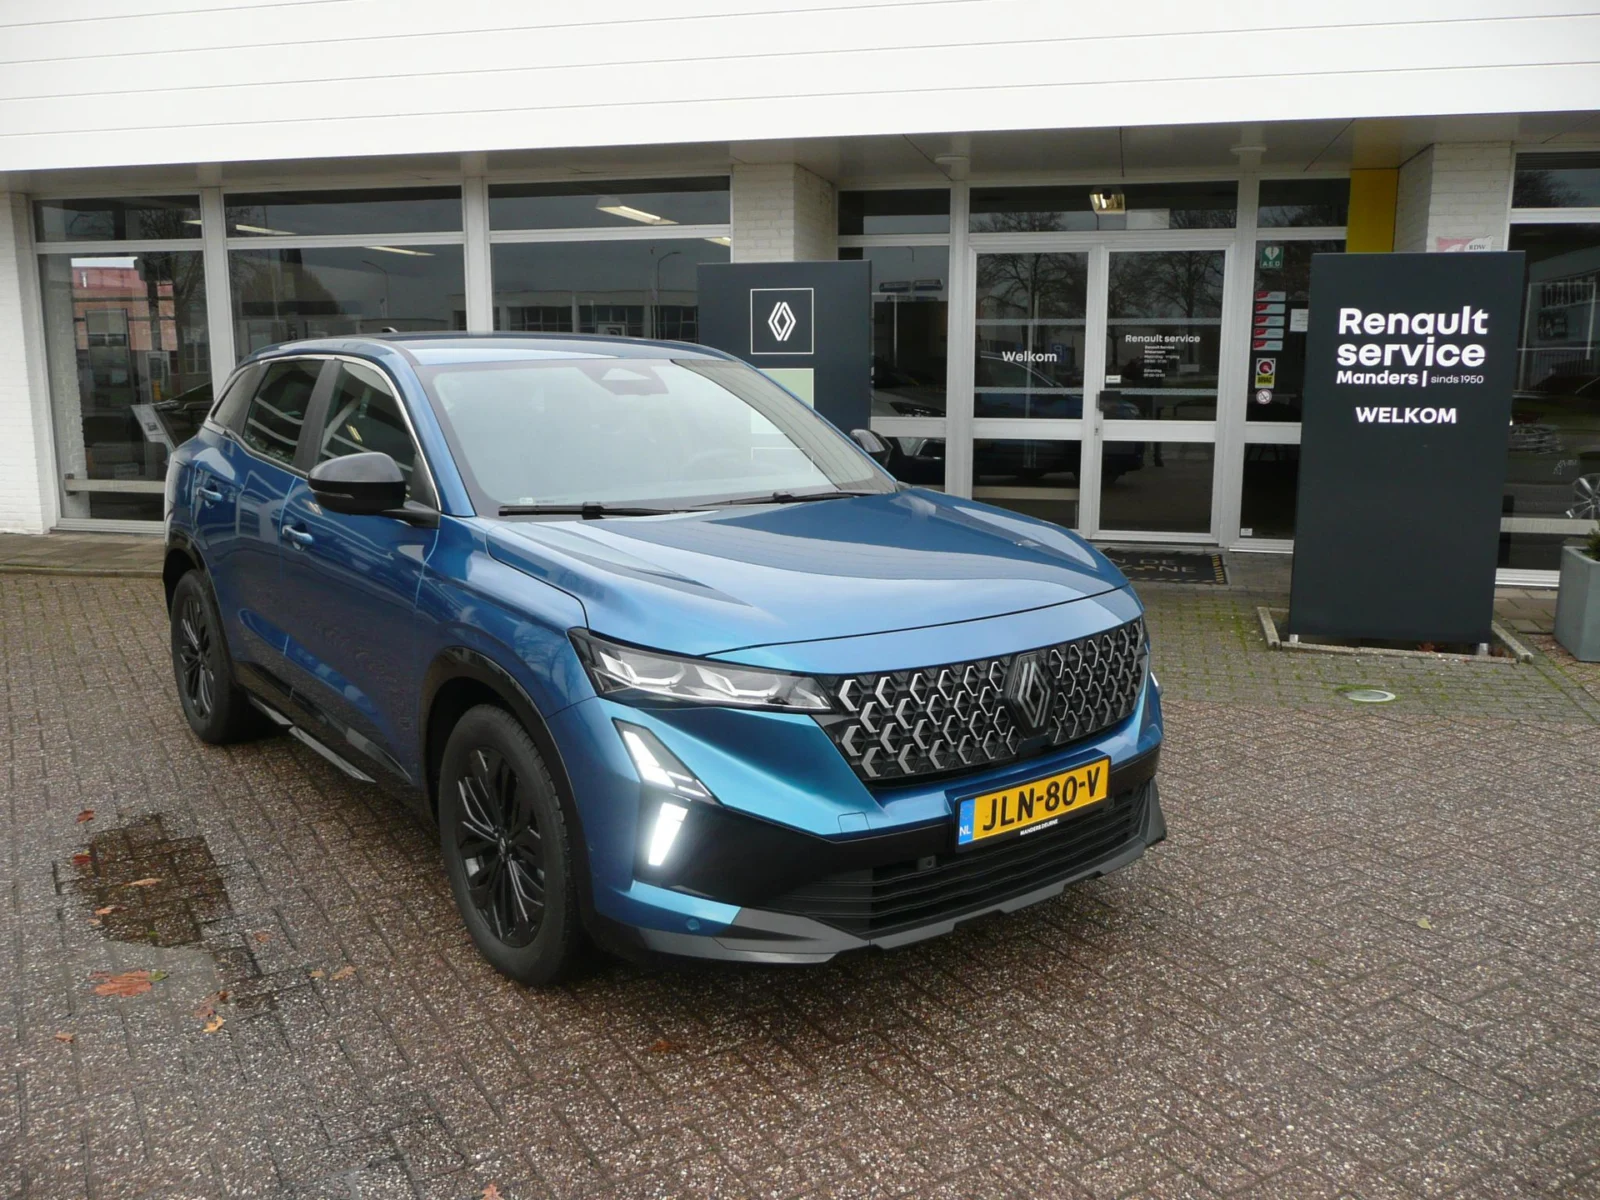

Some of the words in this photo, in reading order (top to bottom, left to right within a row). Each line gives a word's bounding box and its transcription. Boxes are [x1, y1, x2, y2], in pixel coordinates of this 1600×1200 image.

[1338, 306, 1489, 335] Renault
[1125, 334, 1163, 343] Renault
[1164, 335, 1201, 343] service
[1002, 350, 1057, 363] Welkom
[1336, 336, 1486, 367] service
[1336, 370, 1418, 384] Manders
[1431, 375, 1459, 384] sinds
[1460, 375, 1485, 384] 1950
[1355, 406, 1457, 424] WELKOM
[982, 767, 1101, 831] JLN-80-V
[959, 826, 971, 836] NL
